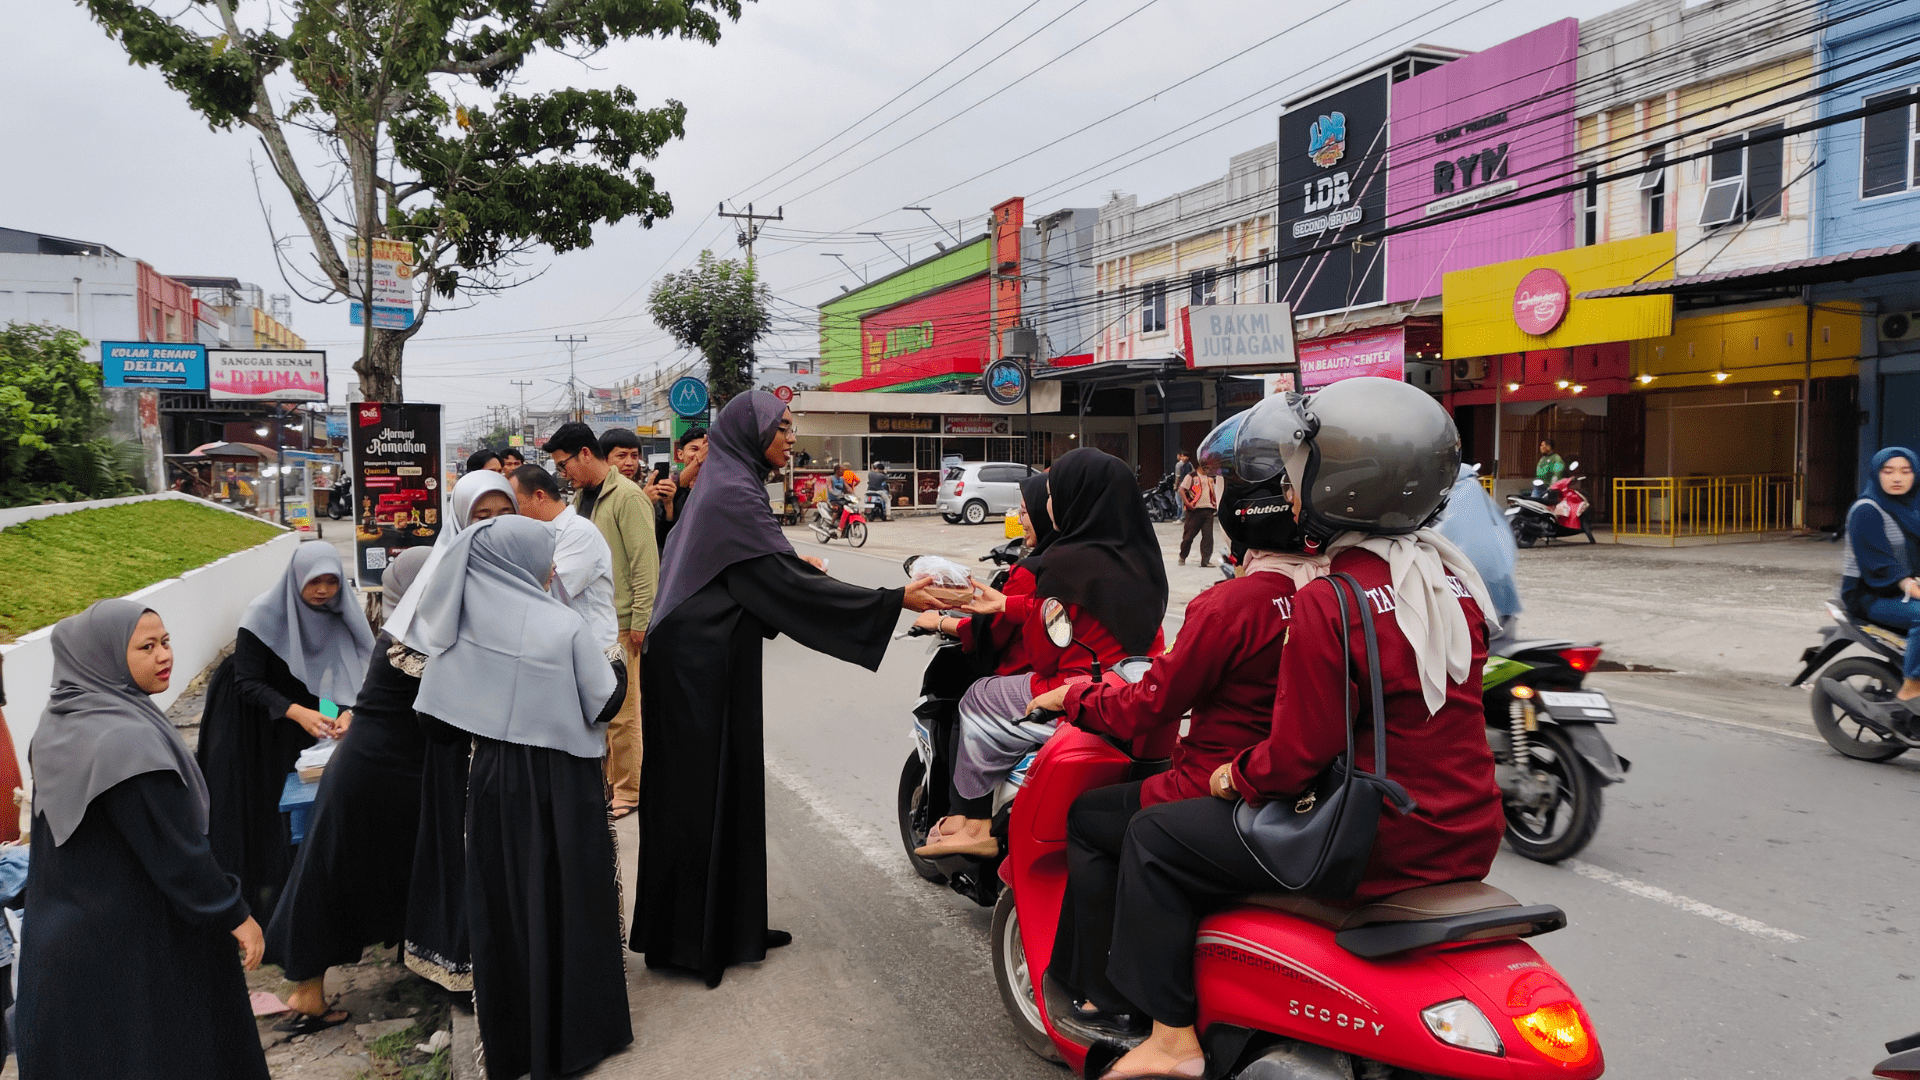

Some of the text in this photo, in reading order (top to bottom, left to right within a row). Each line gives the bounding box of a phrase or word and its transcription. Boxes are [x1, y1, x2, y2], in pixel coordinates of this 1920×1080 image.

[1434, 142, 1508, 195] RYN
[1303, 171, 1350, 214] LDR
[1429, 200, 1456, 212] AESTHETIC
[1461, 196, 1473, 204] ANTI
[1294, 207, 1361, 237] SECOND BRAND
[1210, 313, 1271, 336] BAKMI
[883, 320, 934, 360] JUMBO
[1202, 334, 1285, 358] JURAGAN
[110, 348, 197, 360] KOLAM RENANG
[220, 357, 313, 367] SANGGAR SENAM
[1316, 356, 1350, 371] BEAUTY
[1353, 351, 1391, 367] CENTER
[122, 360, 187, 373] DELIMA
[876, 419, 890, 430] ES
[379, 427, 415, 442] Harmoni
[366, 438, 427, 456] Ramadhan
[1234, 504, 1290, 517] evolution
[1288, 1000, 1384, 1037] SCOOPY
